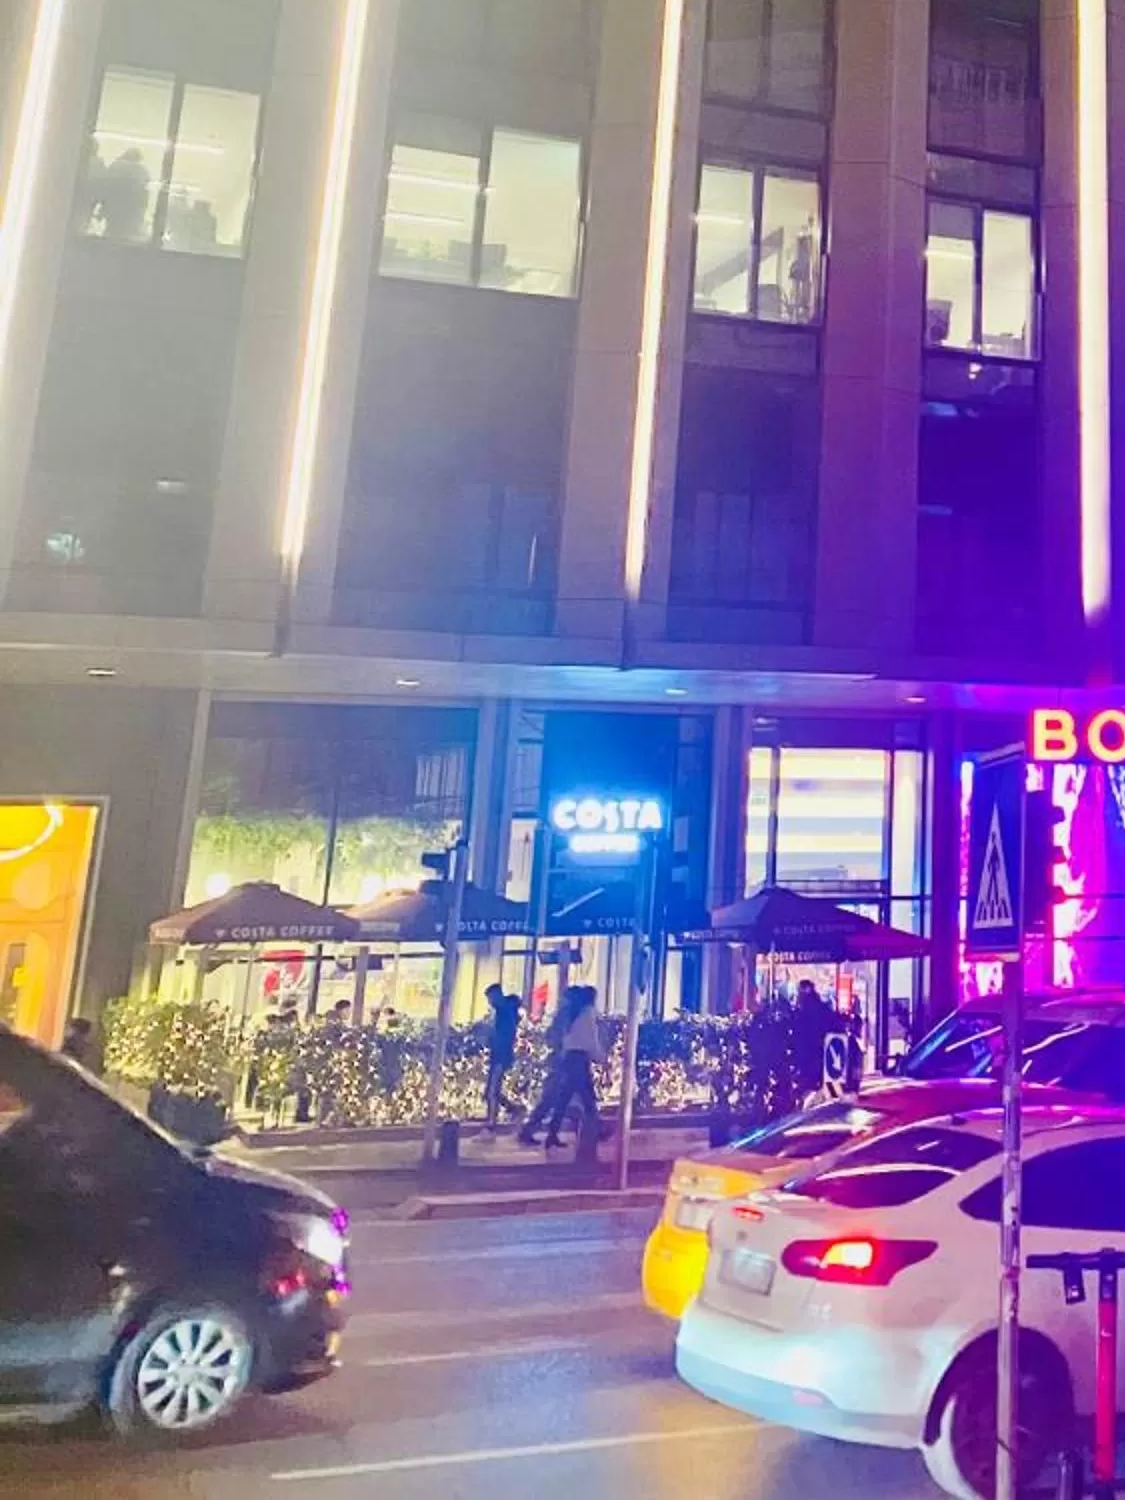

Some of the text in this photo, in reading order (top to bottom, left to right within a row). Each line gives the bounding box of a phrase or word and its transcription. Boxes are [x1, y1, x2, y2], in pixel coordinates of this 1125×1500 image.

[552, 798, 662, 832] COSTA
[231, 924, 336, 939] COSTA COFFEE
[457, 919, 488, 933] OSTA
